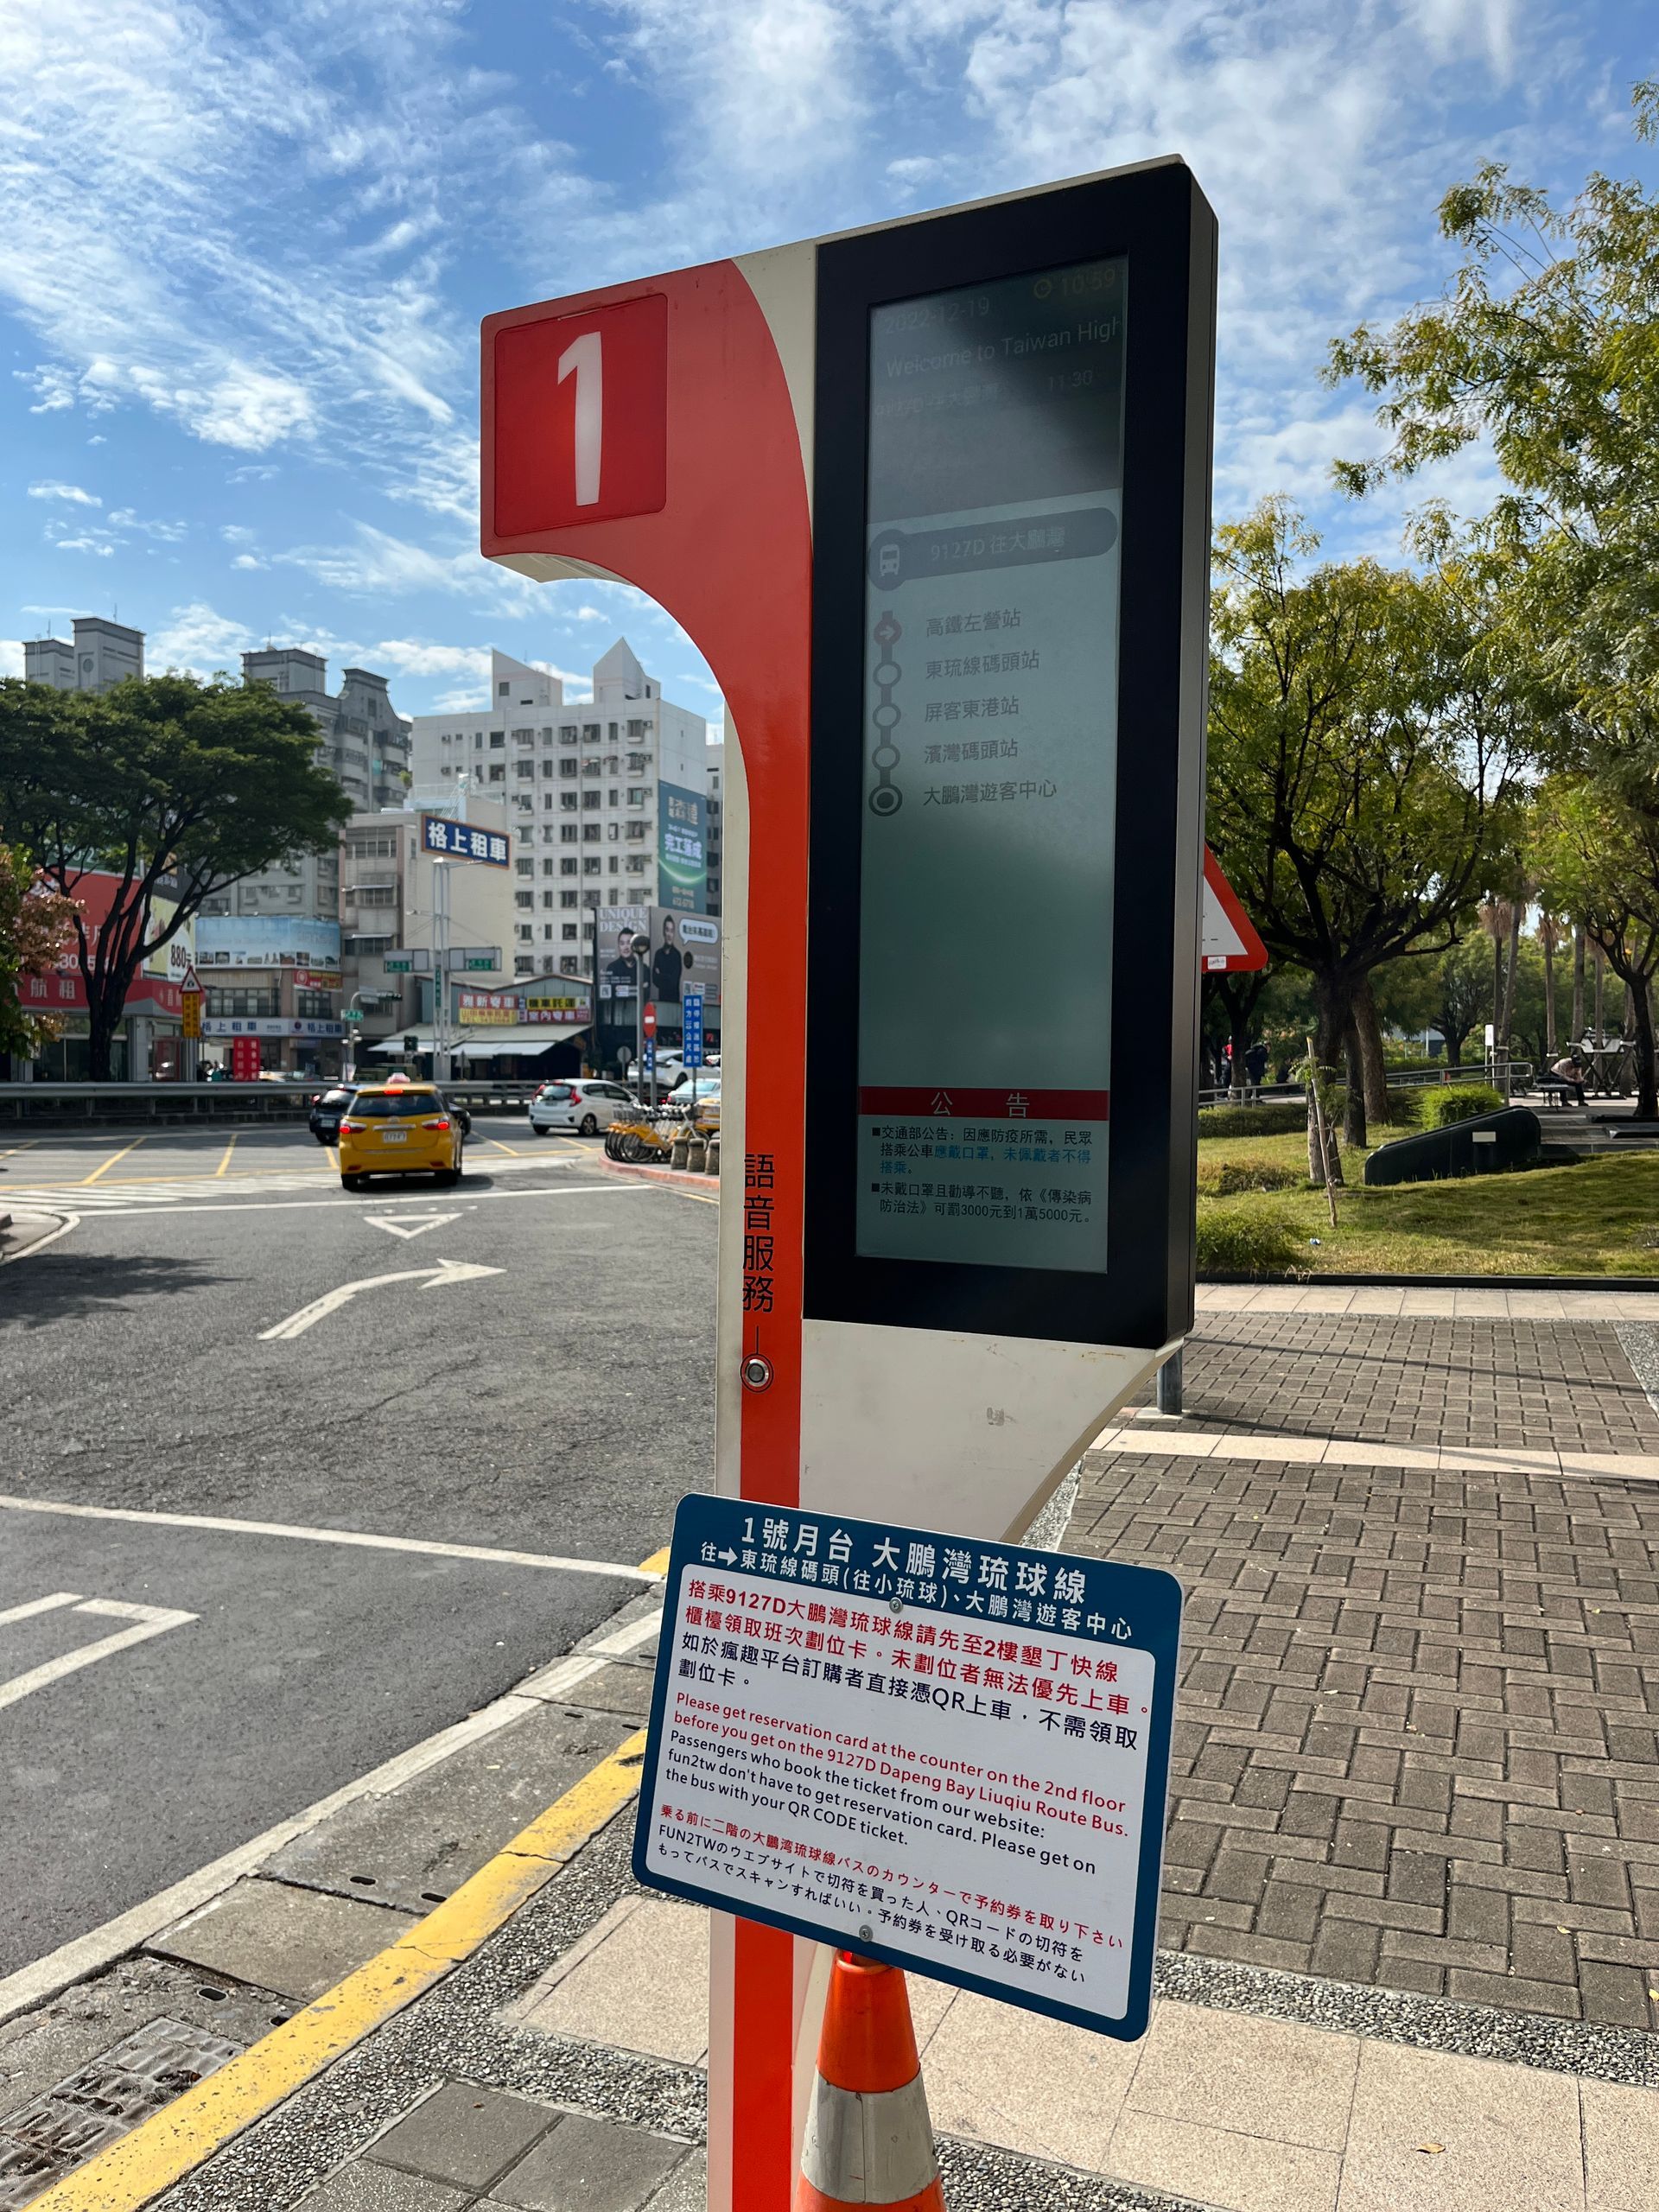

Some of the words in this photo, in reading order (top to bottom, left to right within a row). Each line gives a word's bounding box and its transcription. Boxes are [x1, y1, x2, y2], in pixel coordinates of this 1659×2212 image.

[884, 297, 989, 334] 2022-12-19
[886, 349, 971, 378] Welcome
[977, 345, 995, 362] to
[1001, 328, 1071, 356] Taiwan
[557, 331, 602, 506] 1
[931, 537, 985, 561] 9127D
[925, 607, 1021, 638] 高鐵左營站
[925, 649, 1040, 679] 東琉線碼頭站
[925, 695, 1020, 723] 屏客東港站
[924, 738, 1019, 765] 濱灣碼頭站
[923, 779, 1058, 806] 大鵬灣遊客中心
[429, 822, 506, 861] 格上租車
[600, 908, 646, 919] UNIQUE
[600, 920, 646, 932] DESIGN
[931, 1092, 953, 1116] 公
[1006, 1092, 1030, 1118] 告
[743, 1154, 775, 1313] 語音服務
[701, 1541, 717, 1562] 往
[741, 1517, 853, 1563] 1號月台
[872, 1536, 1085, 1604] 大鵬灣琉球線
[688, 1579, 1118, 1683] 搭乘9127D大鵬灣琉球線請先至2樓墾丁快線
[677, 1658, 749, 1687] 劃位卡。
[685, 1605, 1148, 1715] 櫃檯領取班次劃位卡。未劃位者無法優先上車。
[677, 1692, 720, 1713] Please
[722, 1706, 747, 1720] get
[749, 1712, 832, 1741] reservation
[836, 1733, 868, 1750] card
[871, 1742, 887, 1755] at
[890, 1744, 916, 1762] the
[919, 1754, 984, 1777] counter
[987, 1770, 1008, 1784] on
[1012, 1773, 1040, 1792] the
[1044, 1780, 1077, 1802] 2nd
[1081, 1789, 1126, 1813] floor
[671, 1729, 747, 1761] Passengers
[750, 1751, 781, 1769] who
[784, 1758, 822, 1781] book
[824, 1770, 849, 1787] the
[853, 1777, 897, 1800] ticket
[899, 1788, 938, 1811] from
[942, 1802, 971, 1819] our
[974, 1810, 1045, 1839] website:
[674, 1710, 719, 1733] before
[721, 1725, 747, 1740] you
[750, 1732, 775, 1747] get
[777, 1739, 796, 1752] on
[799, 1742, 824, 1759] the
[827, 1748, 876, 1771] 9127D
[880, 1761, 942, 1792] Dapeng
[945, 1777, 976, 1801] Bay
[979, 1786, 1031, 1812] Liuqiu
[1036, 1800, 1087, 1826] Route
[1091, 1814, 1128, 1837] Bus.
[665, 1768, 688, 1784] the
[690, 1773, 715, 1792] bus
[718, 1783, 748, 1802] with
[750, 1793, 785, 1811] your
[860, 1821, 908, 1846] ticket.
[668, 1748, 717, 1772] fun2tw
[718, 1762, 757, 1783] don't
[759, 1771, 793, 1793] have
[796, 1783, 812, 1797] to
[815, 1790, 841, 1806] get
[843, 1797, 933, 1831] reservation
[937, 1822, 977, 1843] card.
[982, 1831, 1036, 1858] Please
[1039, 1850, 1070, 1867] get
[1073, 1859, 1096, 1875] on
